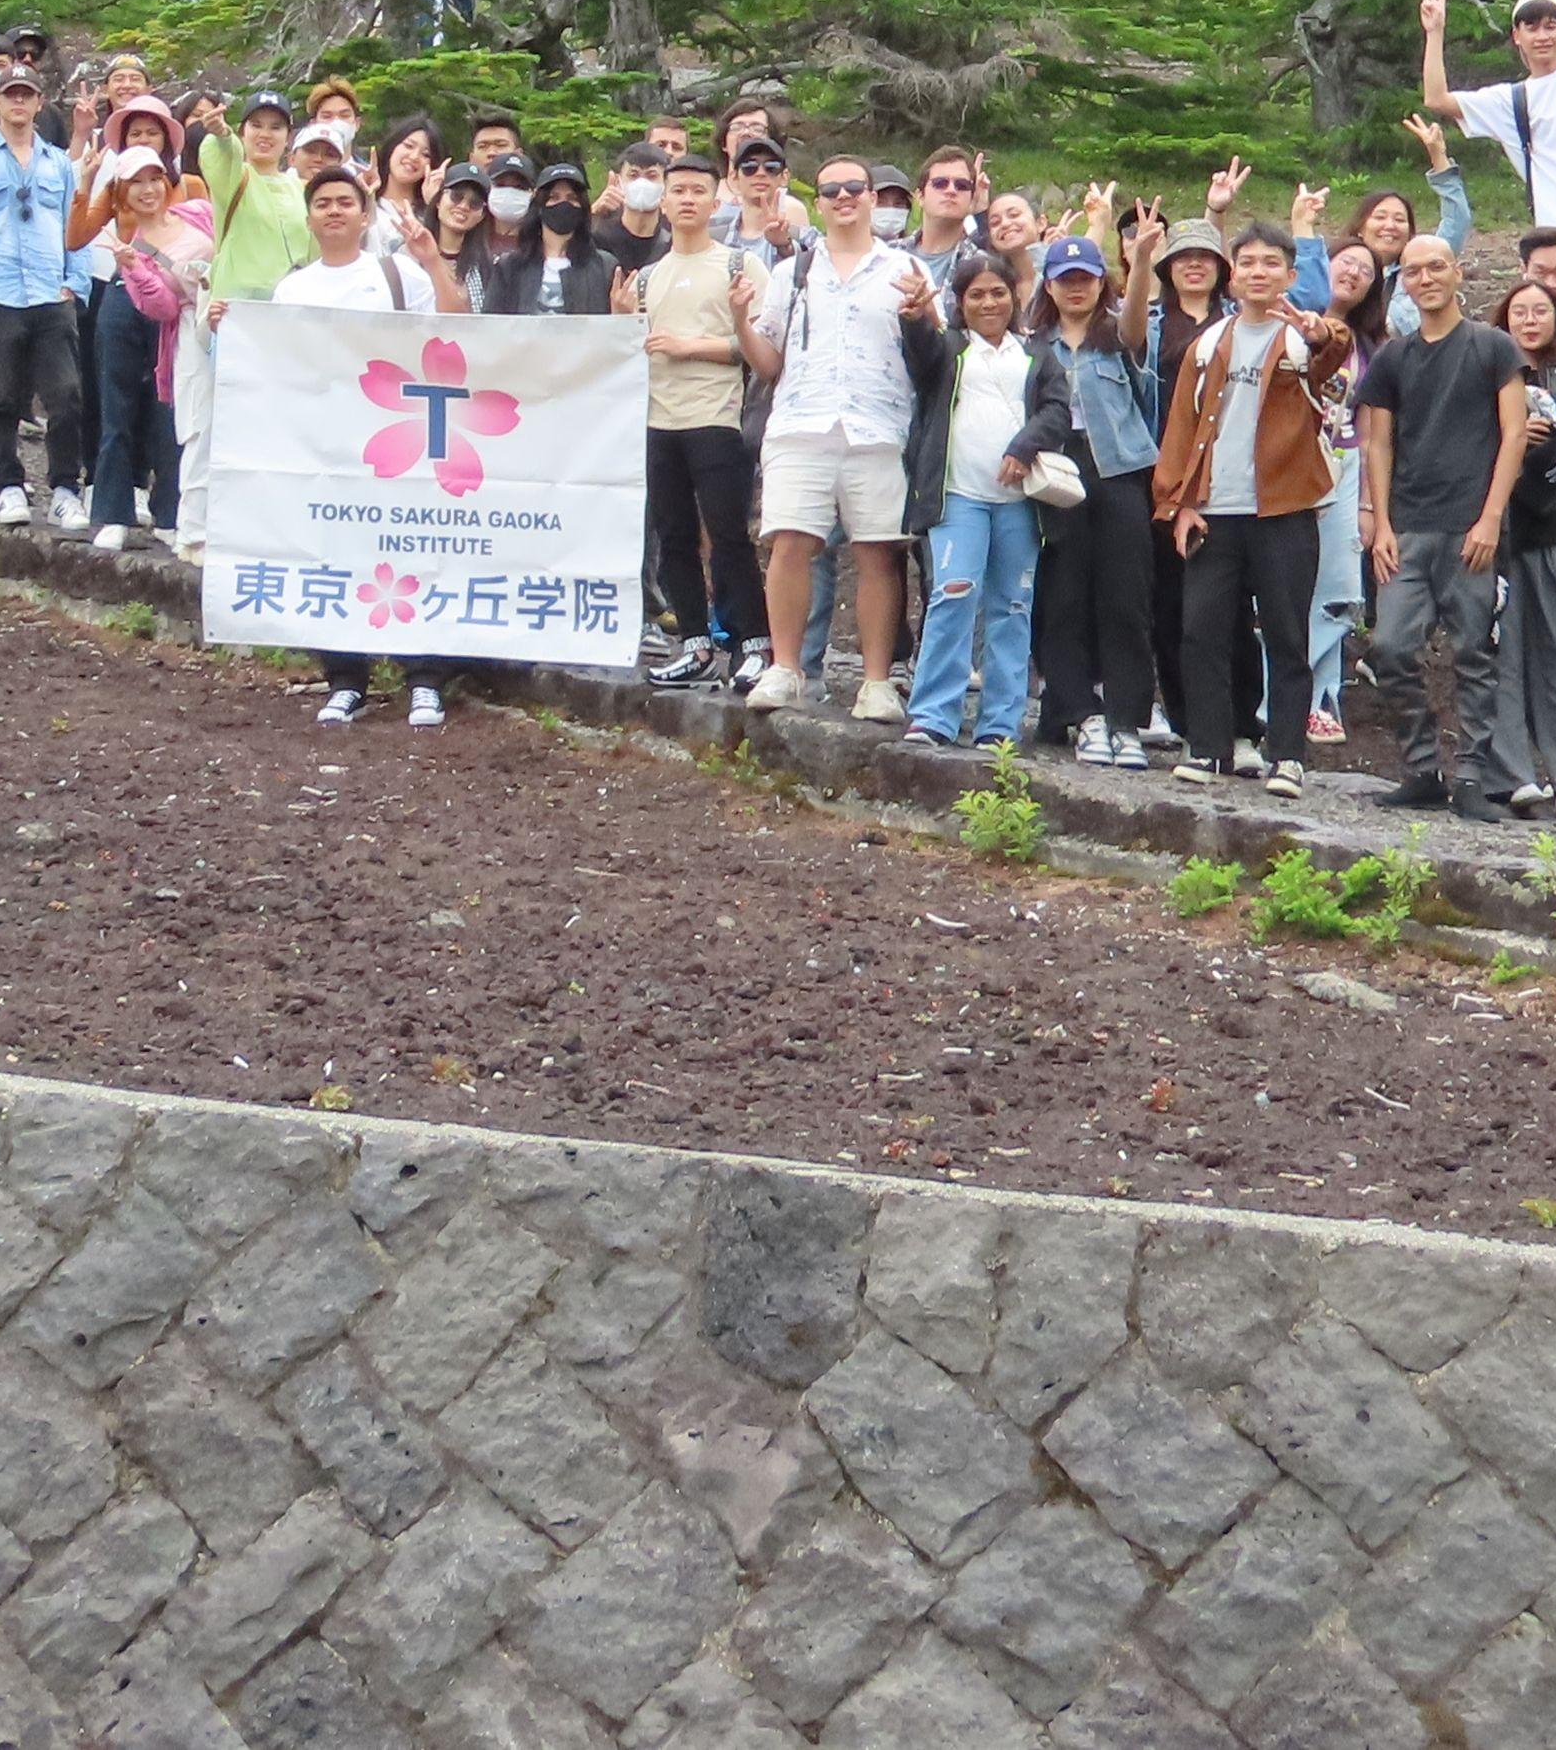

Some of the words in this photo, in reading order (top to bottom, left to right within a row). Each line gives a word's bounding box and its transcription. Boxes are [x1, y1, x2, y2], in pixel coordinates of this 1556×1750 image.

[401, 383, 470, 460] T
[308, 502, 383, 523] TOKYO
[390, 506, 482, 528] SAKURA
[488, 510, 562, 531] GAOKA
[378, 534, 493, 556] INSTITUTE
[231, 560, 353, 620] 東京
